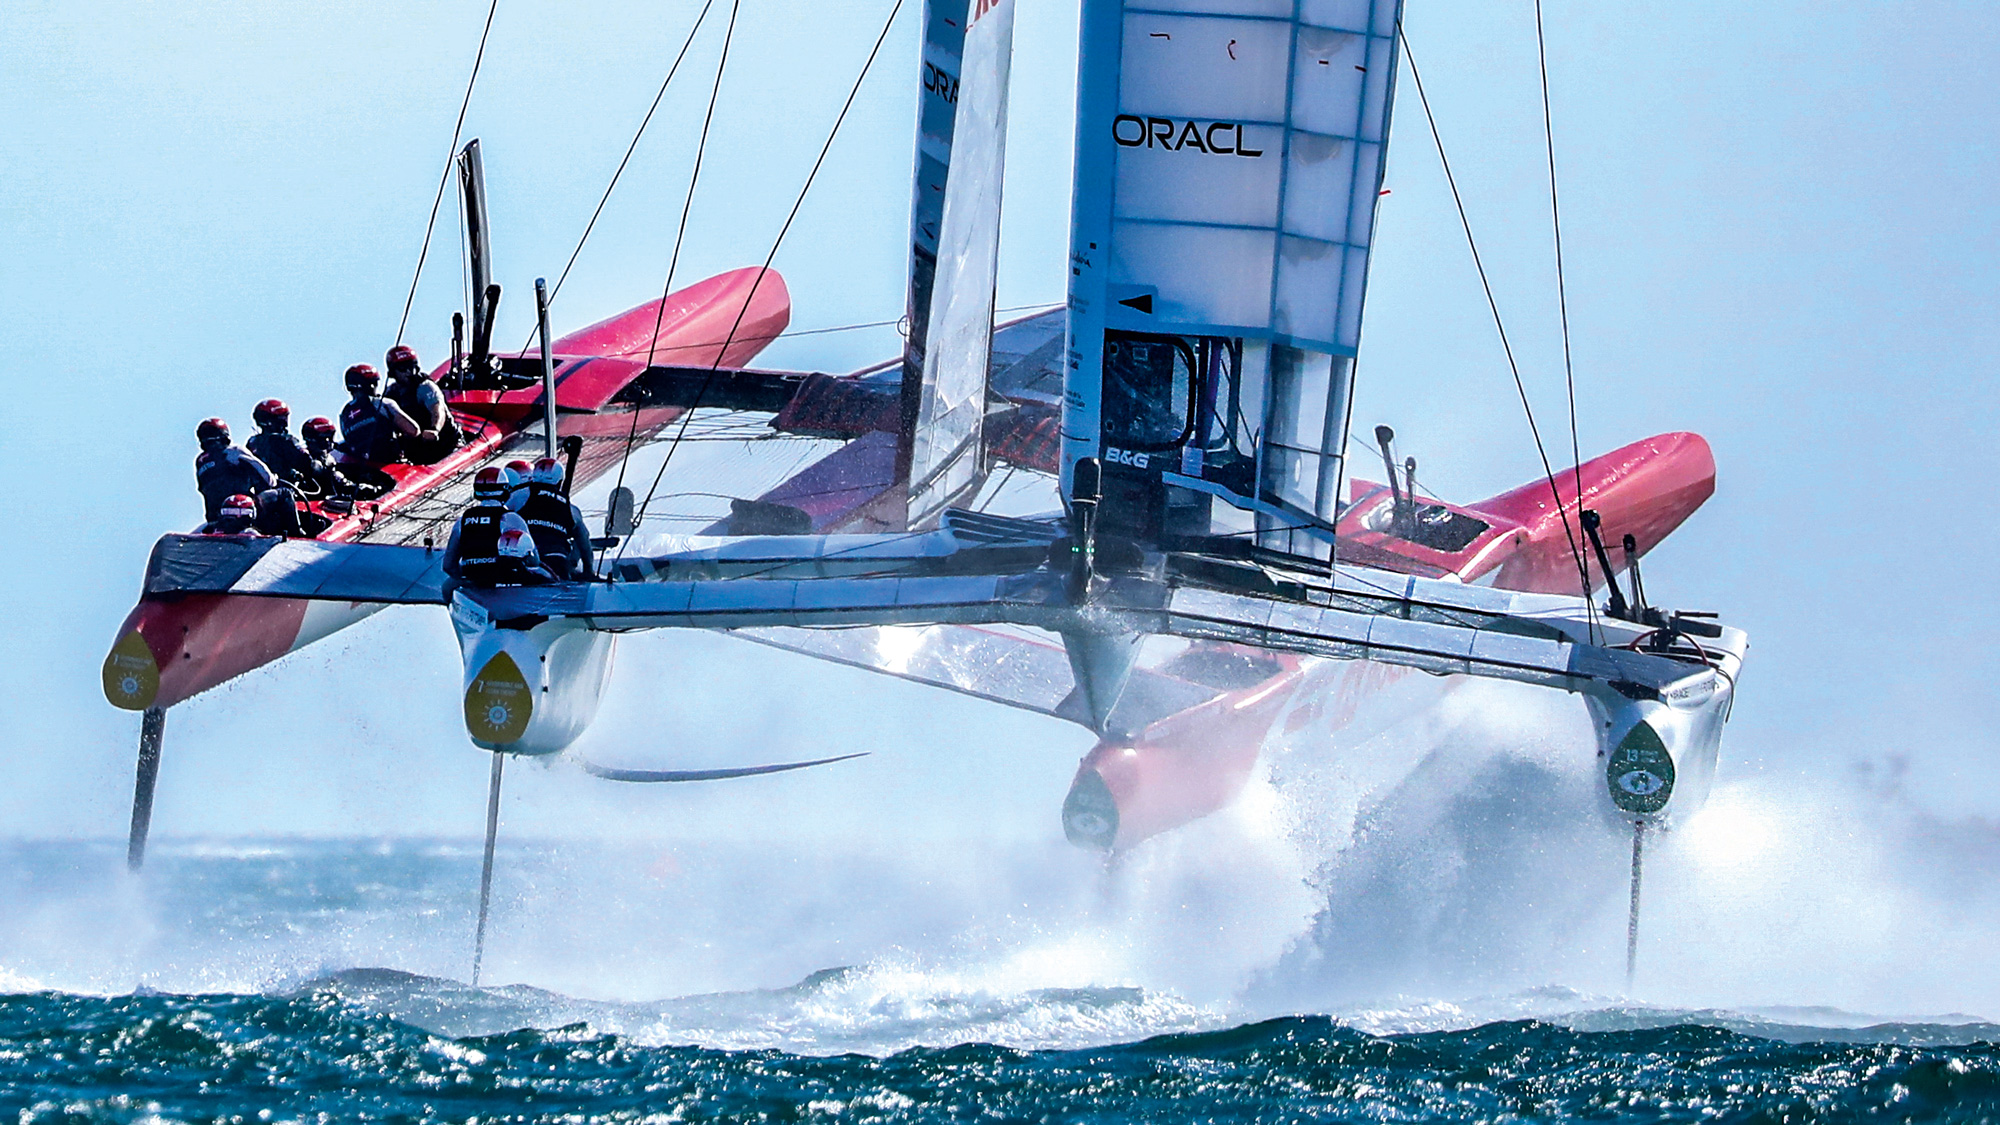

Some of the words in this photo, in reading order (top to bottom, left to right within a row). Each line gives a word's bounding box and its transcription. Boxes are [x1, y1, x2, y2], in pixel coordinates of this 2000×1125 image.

[1112, 113, 1263, 158] ORACL
[1104, 446, 1150, 469] B&G
[1626, 748, 1639, 762] 13
